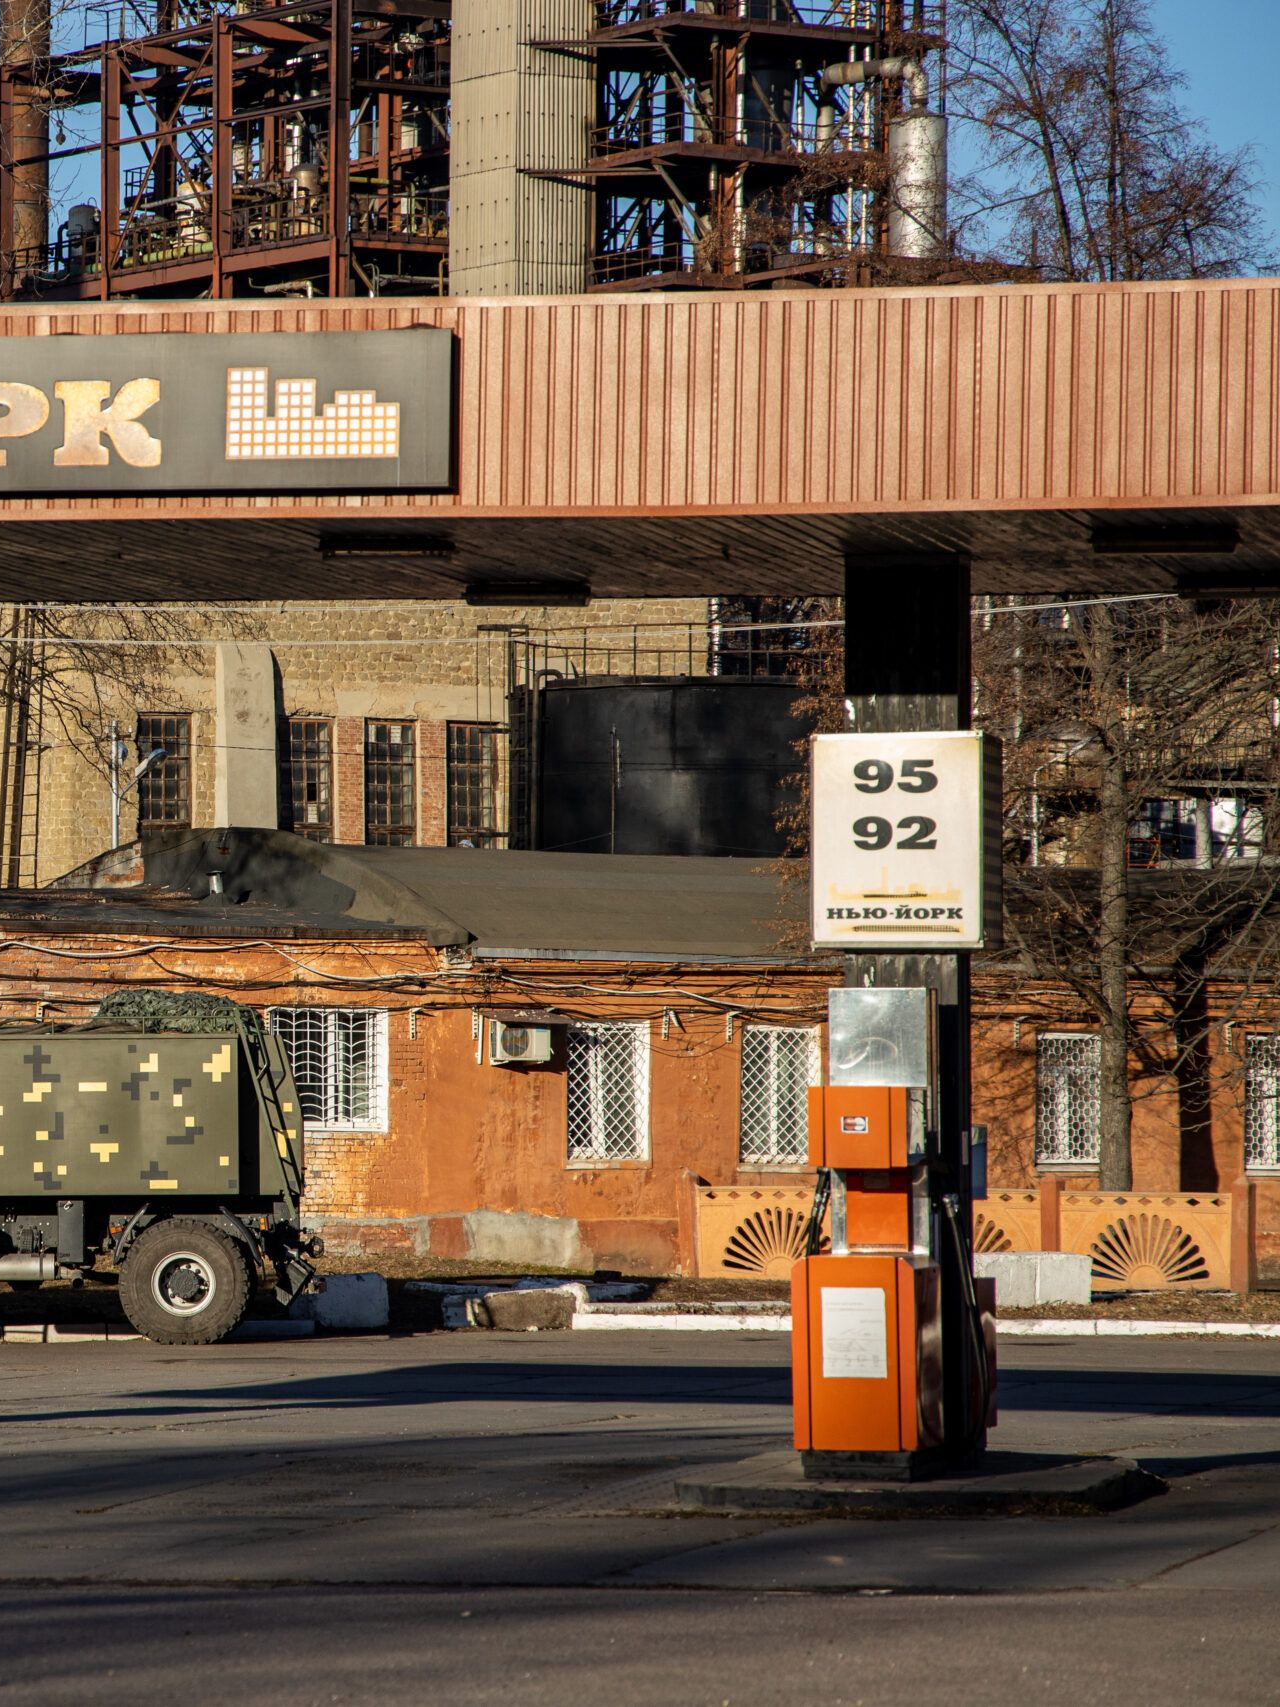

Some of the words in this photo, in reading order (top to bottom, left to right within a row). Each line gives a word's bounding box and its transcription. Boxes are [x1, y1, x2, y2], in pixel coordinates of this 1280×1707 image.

[853, 758, 938, 794] 95
[852, 815, 938, 851] 92
[826, 904, 963, 920] НЬЮ-ЙОРК
